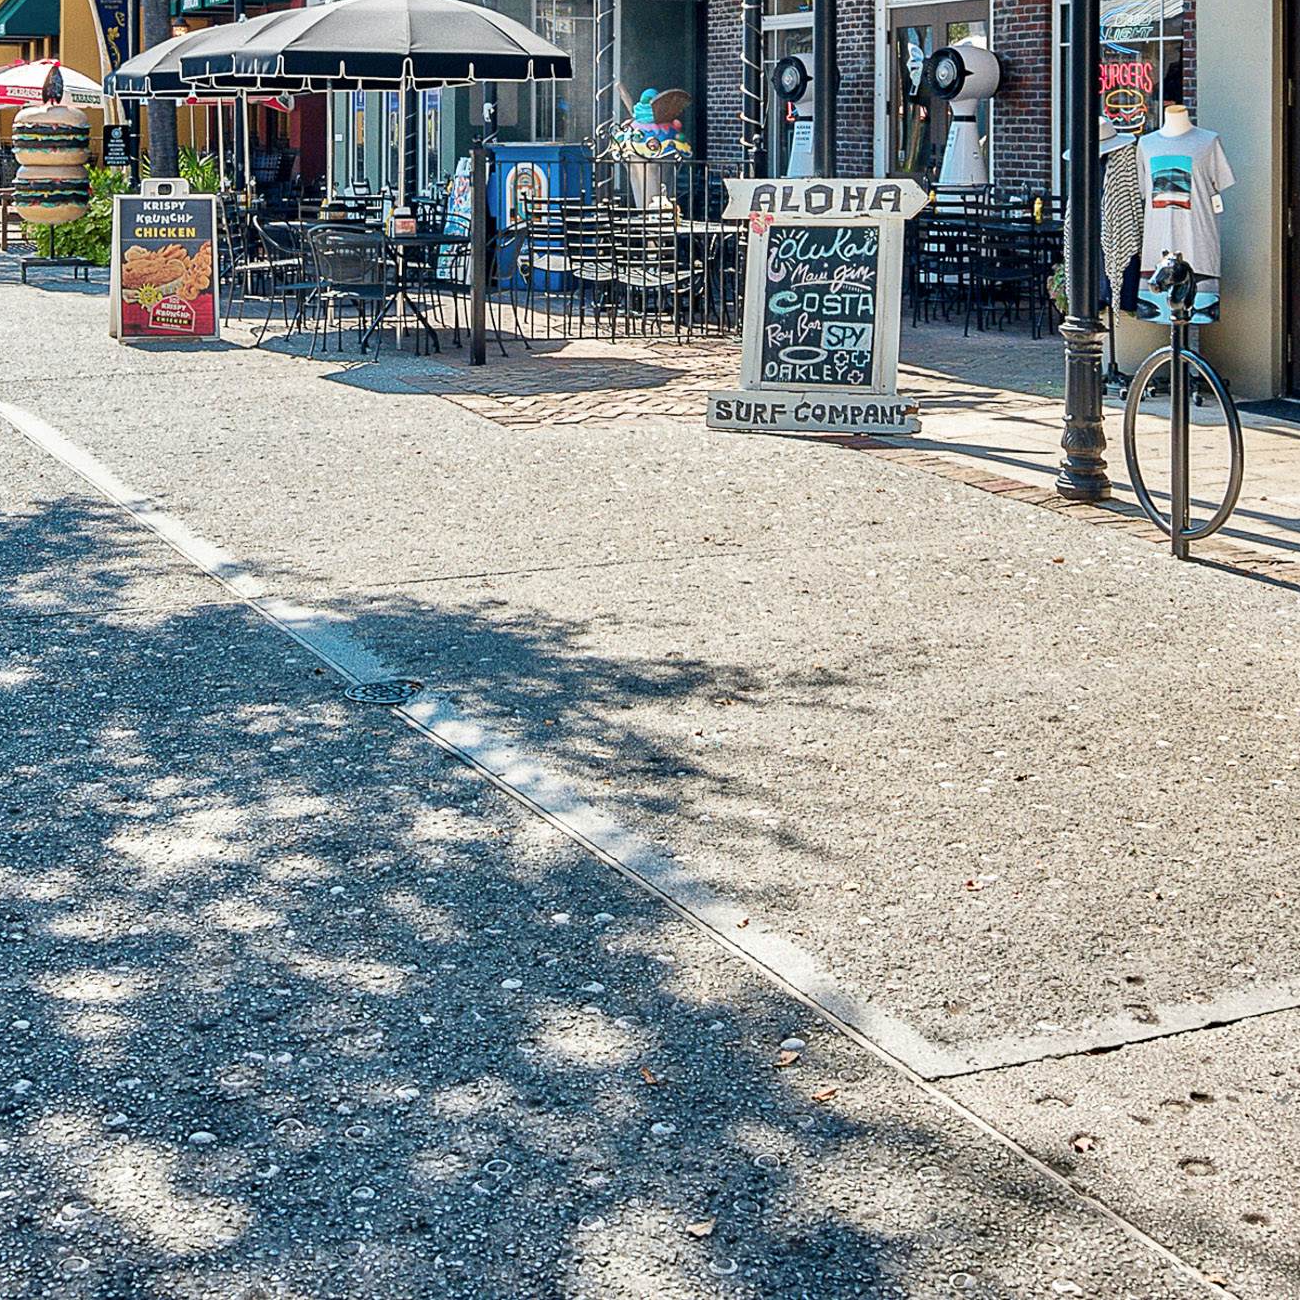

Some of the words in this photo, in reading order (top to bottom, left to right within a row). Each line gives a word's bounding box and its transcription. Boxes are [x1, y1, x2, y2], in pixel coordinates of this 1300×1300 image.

[1105, 26, 1154, 41] LIGHT
[143, 201, 186, 210] KRISPY
[750, 184, 901, 215] ALOHA
[136, 213, 193, 225] KRUNCHY
[135, 227, 196, 238] CHICKEN
[769, 290, 874, 316] COSTA
[827, 325, 866, 349] SPY
[765, 361, 848, 382] OAKLEY
[715, 400, 786, 426] SURF
[794, 401, 908, 427] COMPANY
